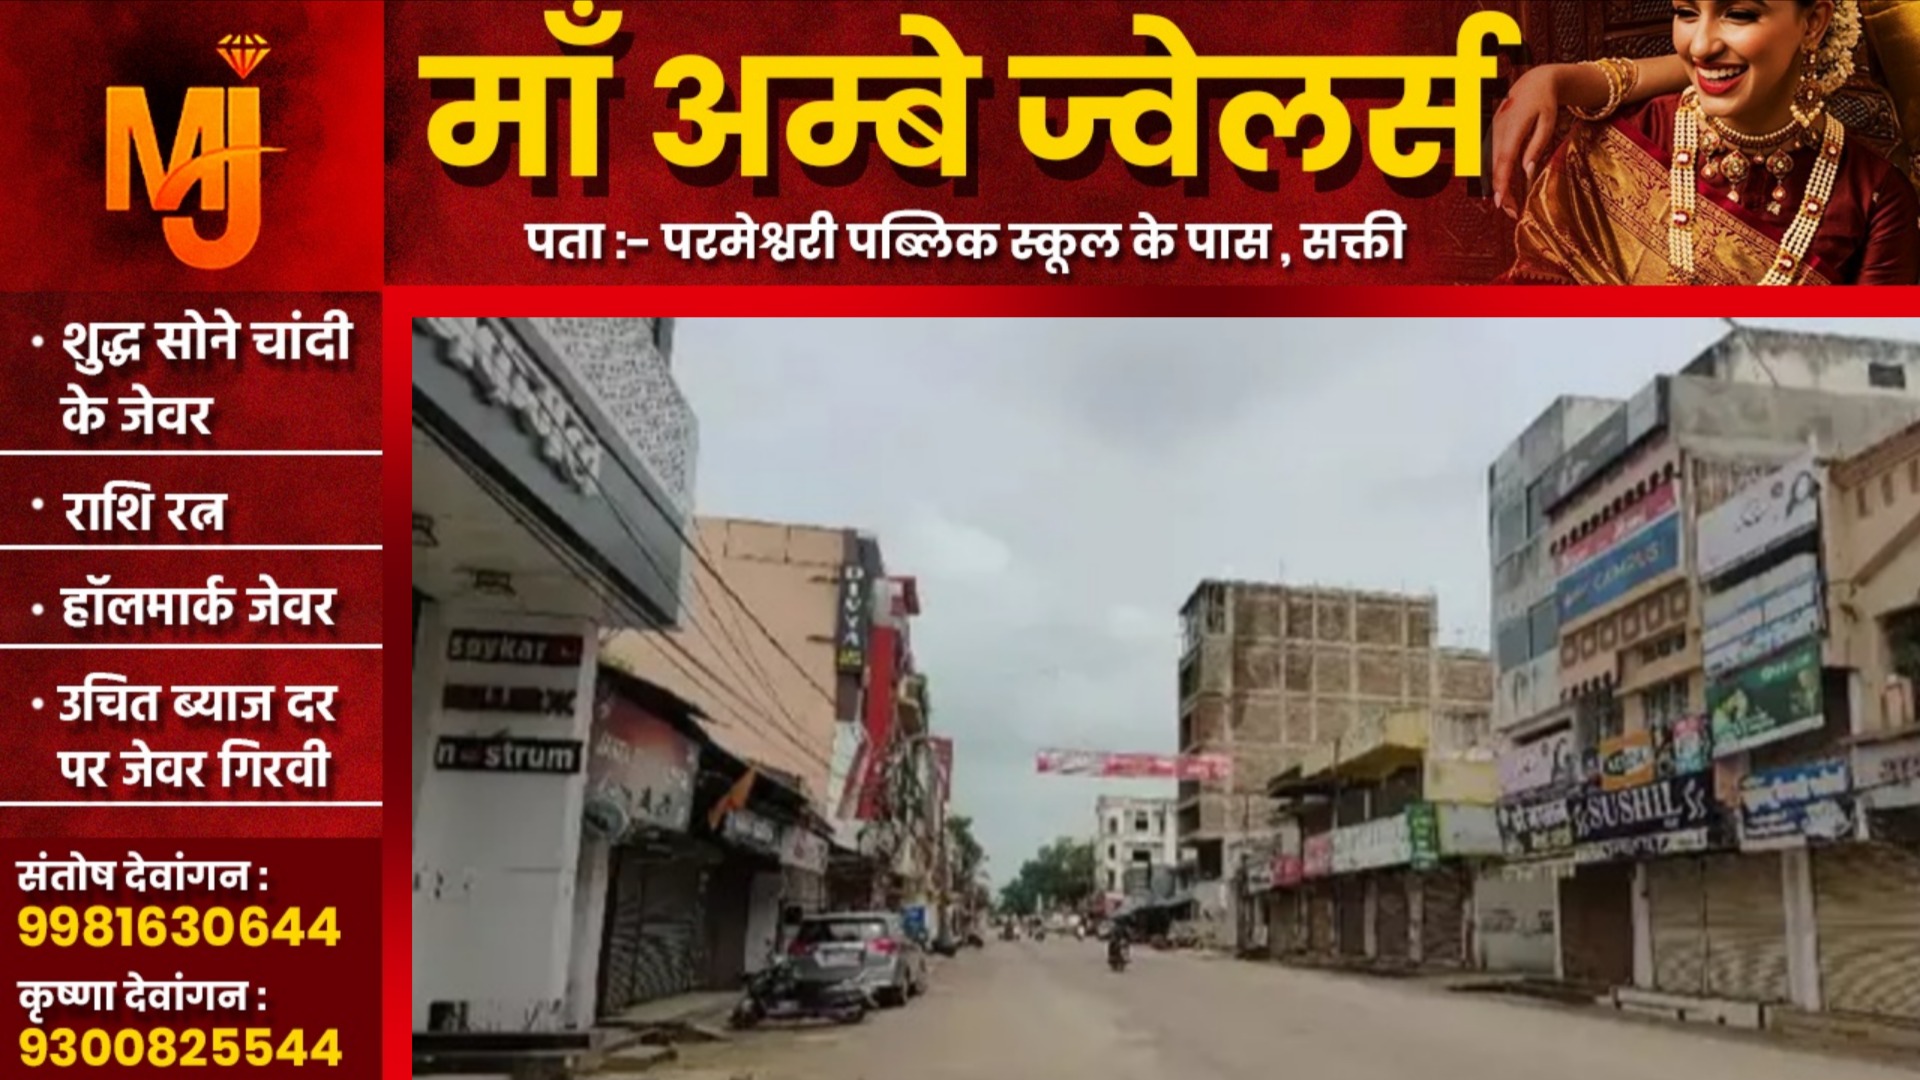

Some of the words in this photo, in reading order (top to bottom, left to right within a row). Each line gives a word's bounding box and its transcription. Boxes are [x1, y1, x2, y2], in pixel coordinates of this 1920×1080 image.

[844, 565, 864, 645] DIVYA
[438, 741, 574, 769] nstrum
[1588, 780, 1682, 828] SUSHIL
